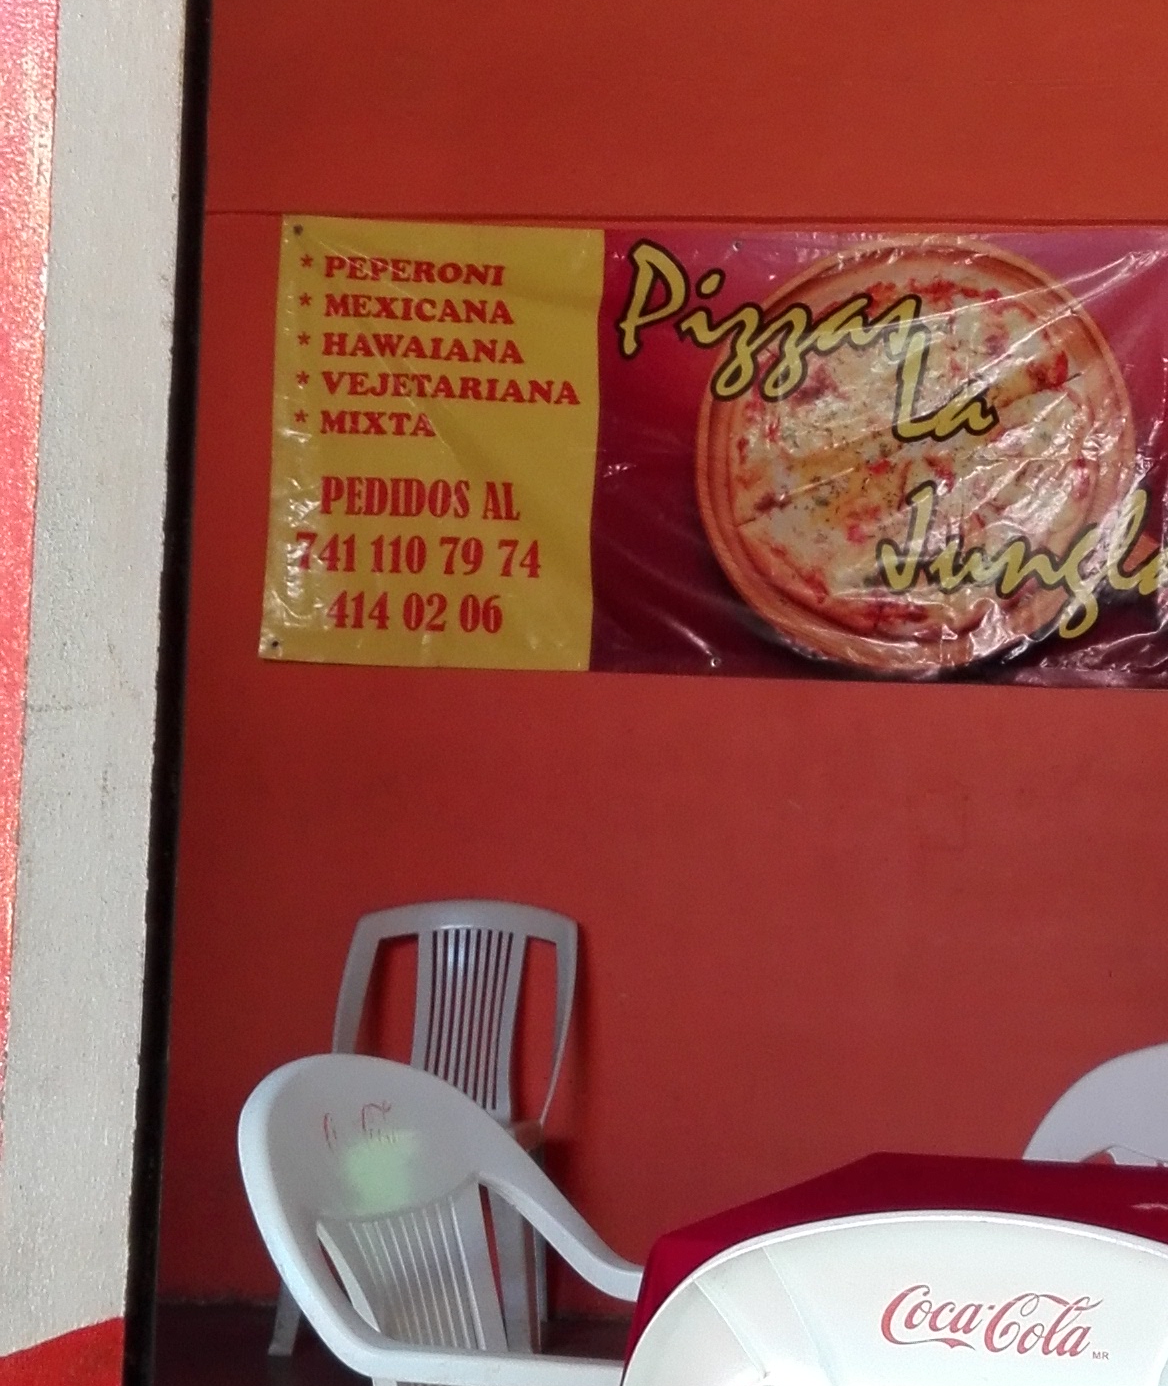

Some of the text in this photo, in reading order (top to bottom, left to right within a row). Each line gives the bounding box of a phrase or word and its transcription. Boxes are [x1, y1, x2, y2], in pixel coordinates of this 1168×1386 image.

[324, 255, 506, 287] PEPERONI
[324, 292, 515, 325] MEXICANA
[321, 332, 525, 365] HAWAIANA
[321, 371, 581, 406] VEJETARIANA
[889, 318, 998, 443] La
[319, 411, 436, 438] MIXTA
[320, 475, 521, 521] PEDIDOS AL
[295, 531, 542, 579] 741 110 79 74
[327, 590, 504, 634] 414 02 06
[880, 1284, 1104, 1358] Coca-Cola
